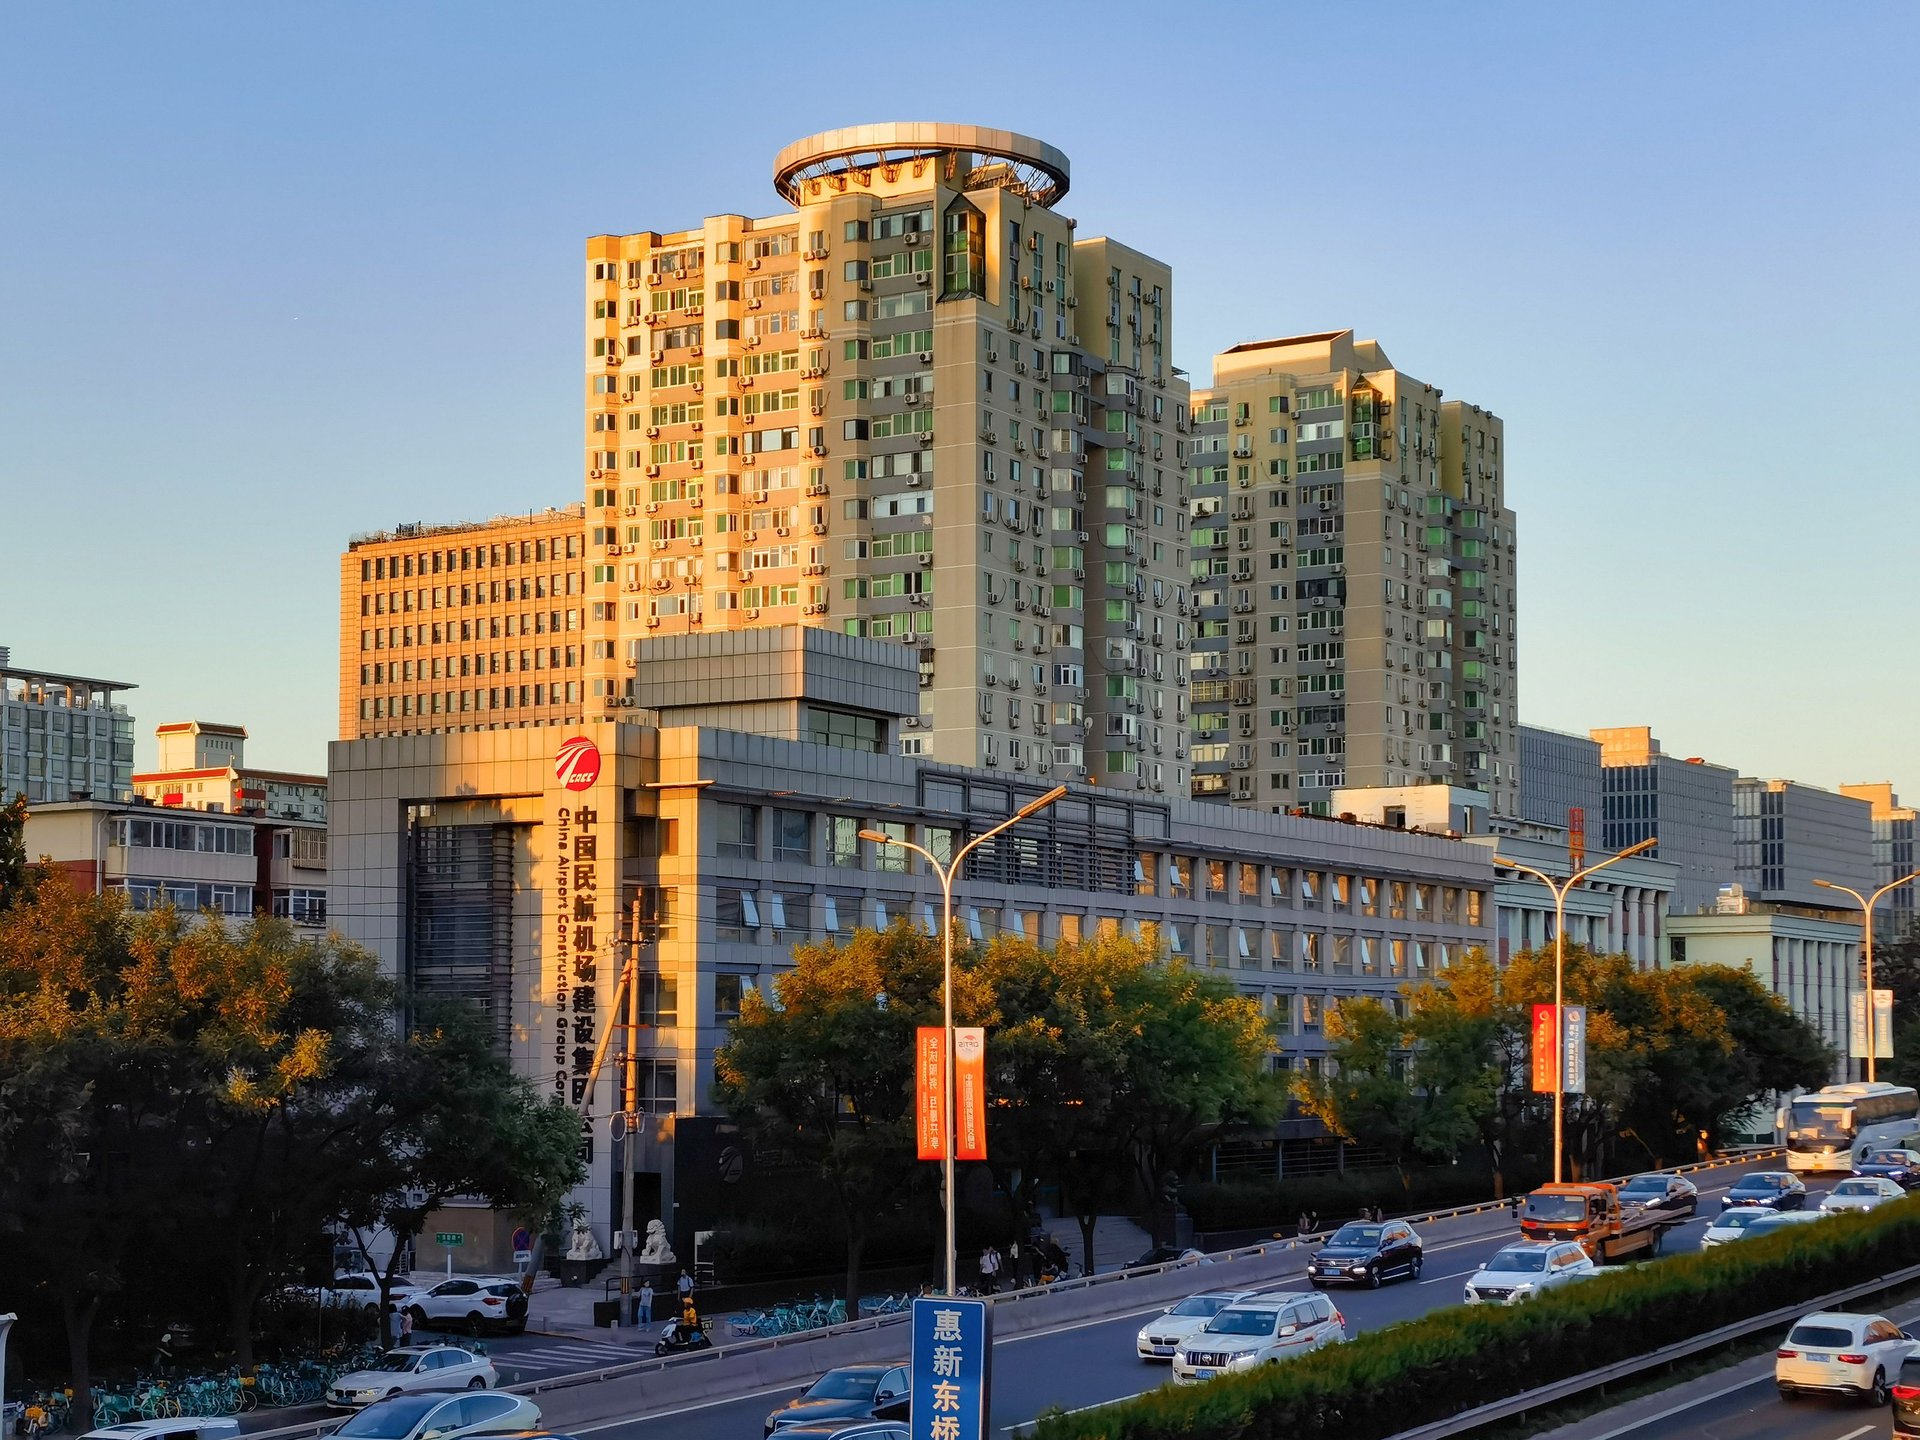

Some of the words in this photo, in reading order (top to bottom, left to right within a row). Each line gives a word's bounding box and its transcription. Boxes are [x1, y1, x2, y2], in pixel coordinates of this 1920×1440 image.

[569, 772, 594, 783] CACC
[558, 807, 570, 850] China
[555, 855, 570, 909] Airport
[556, 914, 569, 1012] Construction
[553, 1017, 568, 1065] Group
[930, 1308, 963, 1440] 惠新东桥
